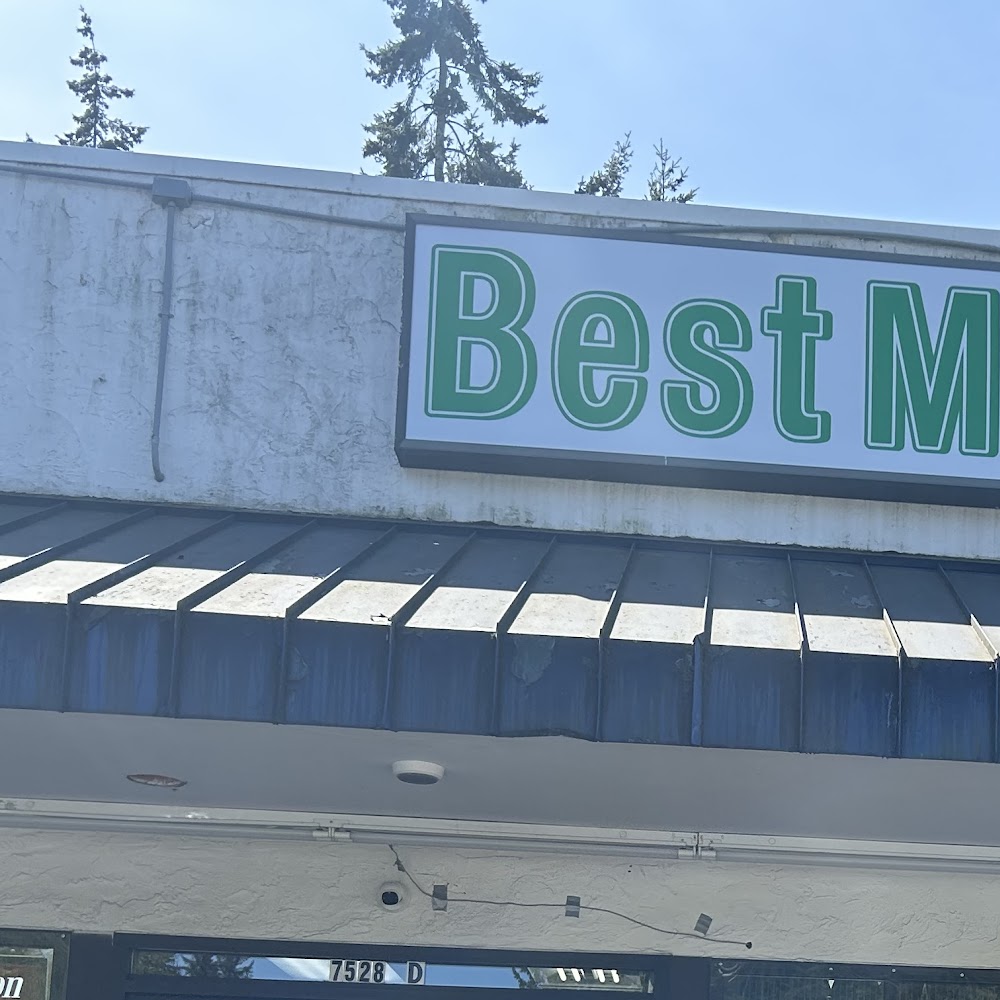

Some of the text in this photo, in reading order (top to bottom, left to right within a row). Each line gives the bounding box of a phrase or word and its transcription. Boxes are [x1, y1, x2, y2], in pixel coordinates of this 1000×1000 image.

[424, 243, 834, 444] Best
[330, 960, 424, 983] 7528 D
